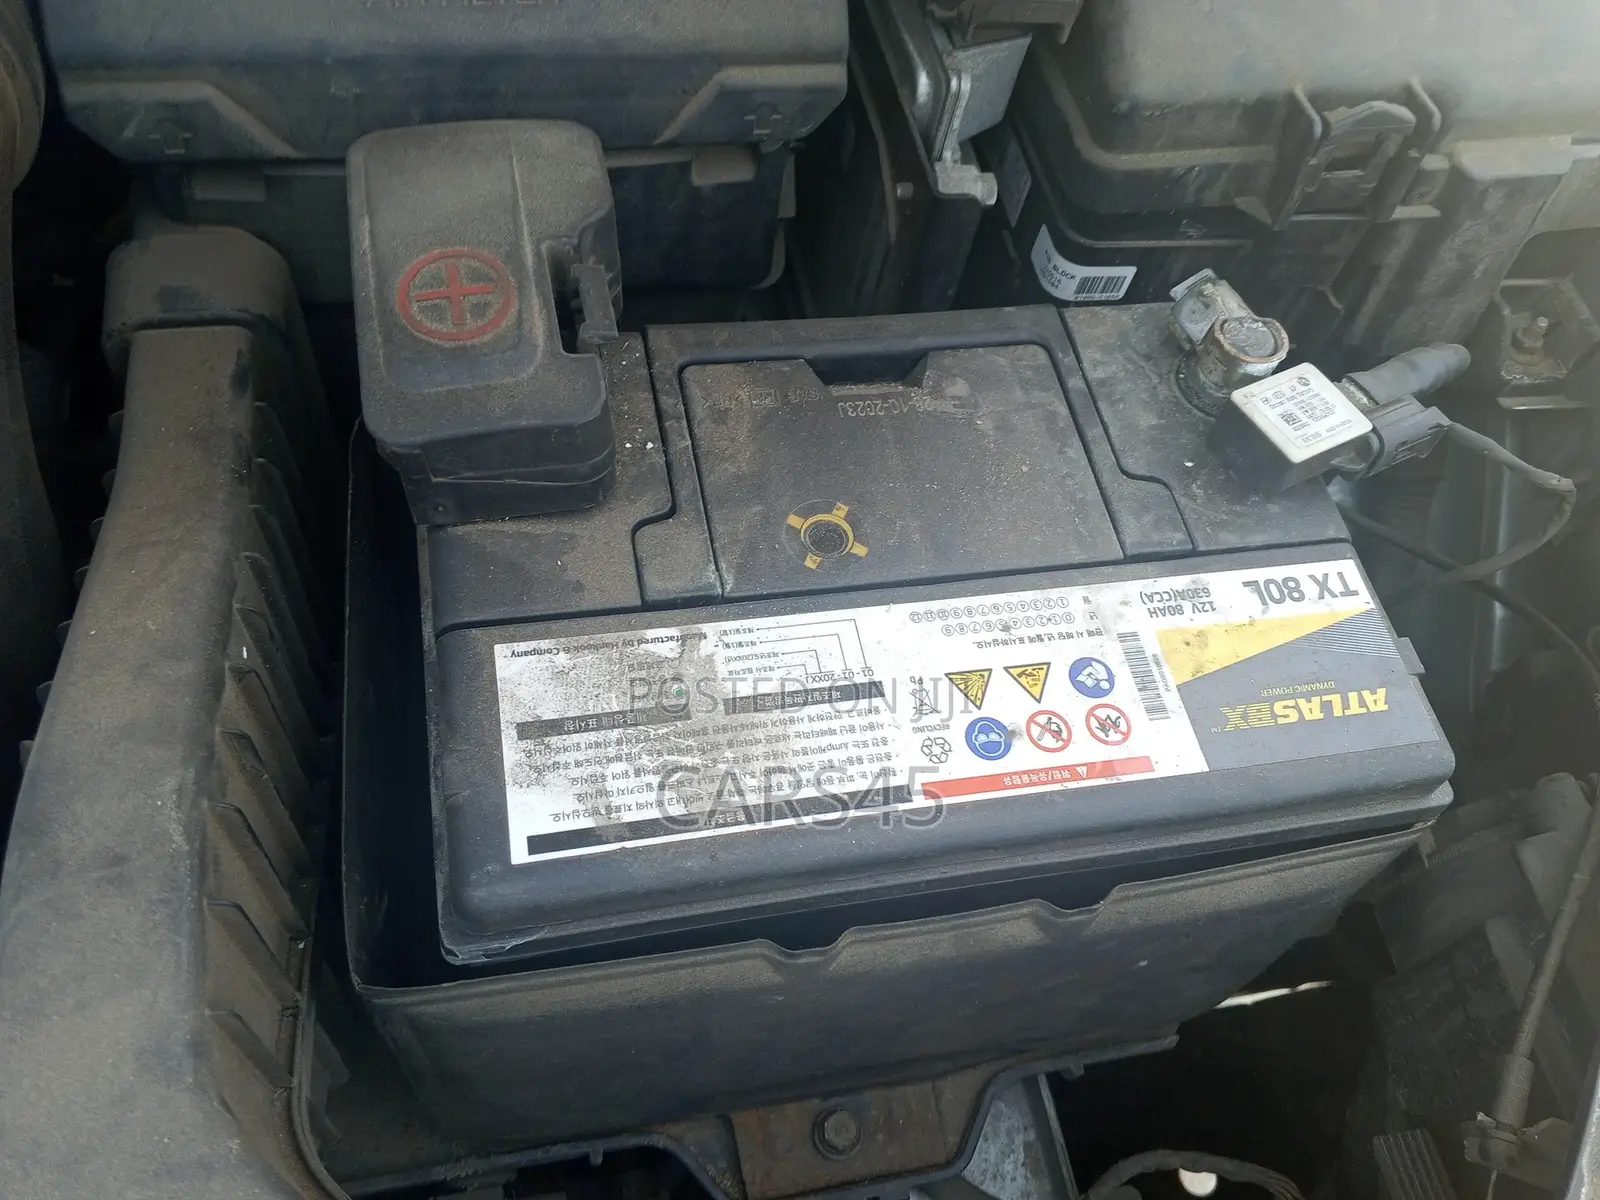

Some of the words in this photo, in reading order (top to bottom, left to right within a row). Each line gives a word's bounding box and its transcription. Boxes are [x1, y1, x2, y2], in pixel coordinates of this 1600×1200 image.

[1052, 264, 1077, 281] BLOCK
[1242, 576, 1306, 606] 80L
[1308, 571, 1360, 600] TX
[1140, 586, 1211, 604] 630A(CCA)
[1148, 605, 1185, 618] 80AH
[1191, 601, 1217, 613] 12V
[1056, 631, 1073, 639] 해당
[1085, 627, 1103, 636] 판매
[621, 637, 633, 647] by
[637, 632, 706, 646] Manufactured
[510, 646, 558, 658] Company
[571, 641, 618, 652] Hankook
[910, 675, 924, 685] Pb
[1294, 680, 1335, 692] DYNAMIC
[1260, 684, 1294, 697] POWER
[912, 723, 950, 734] RECYCLING
